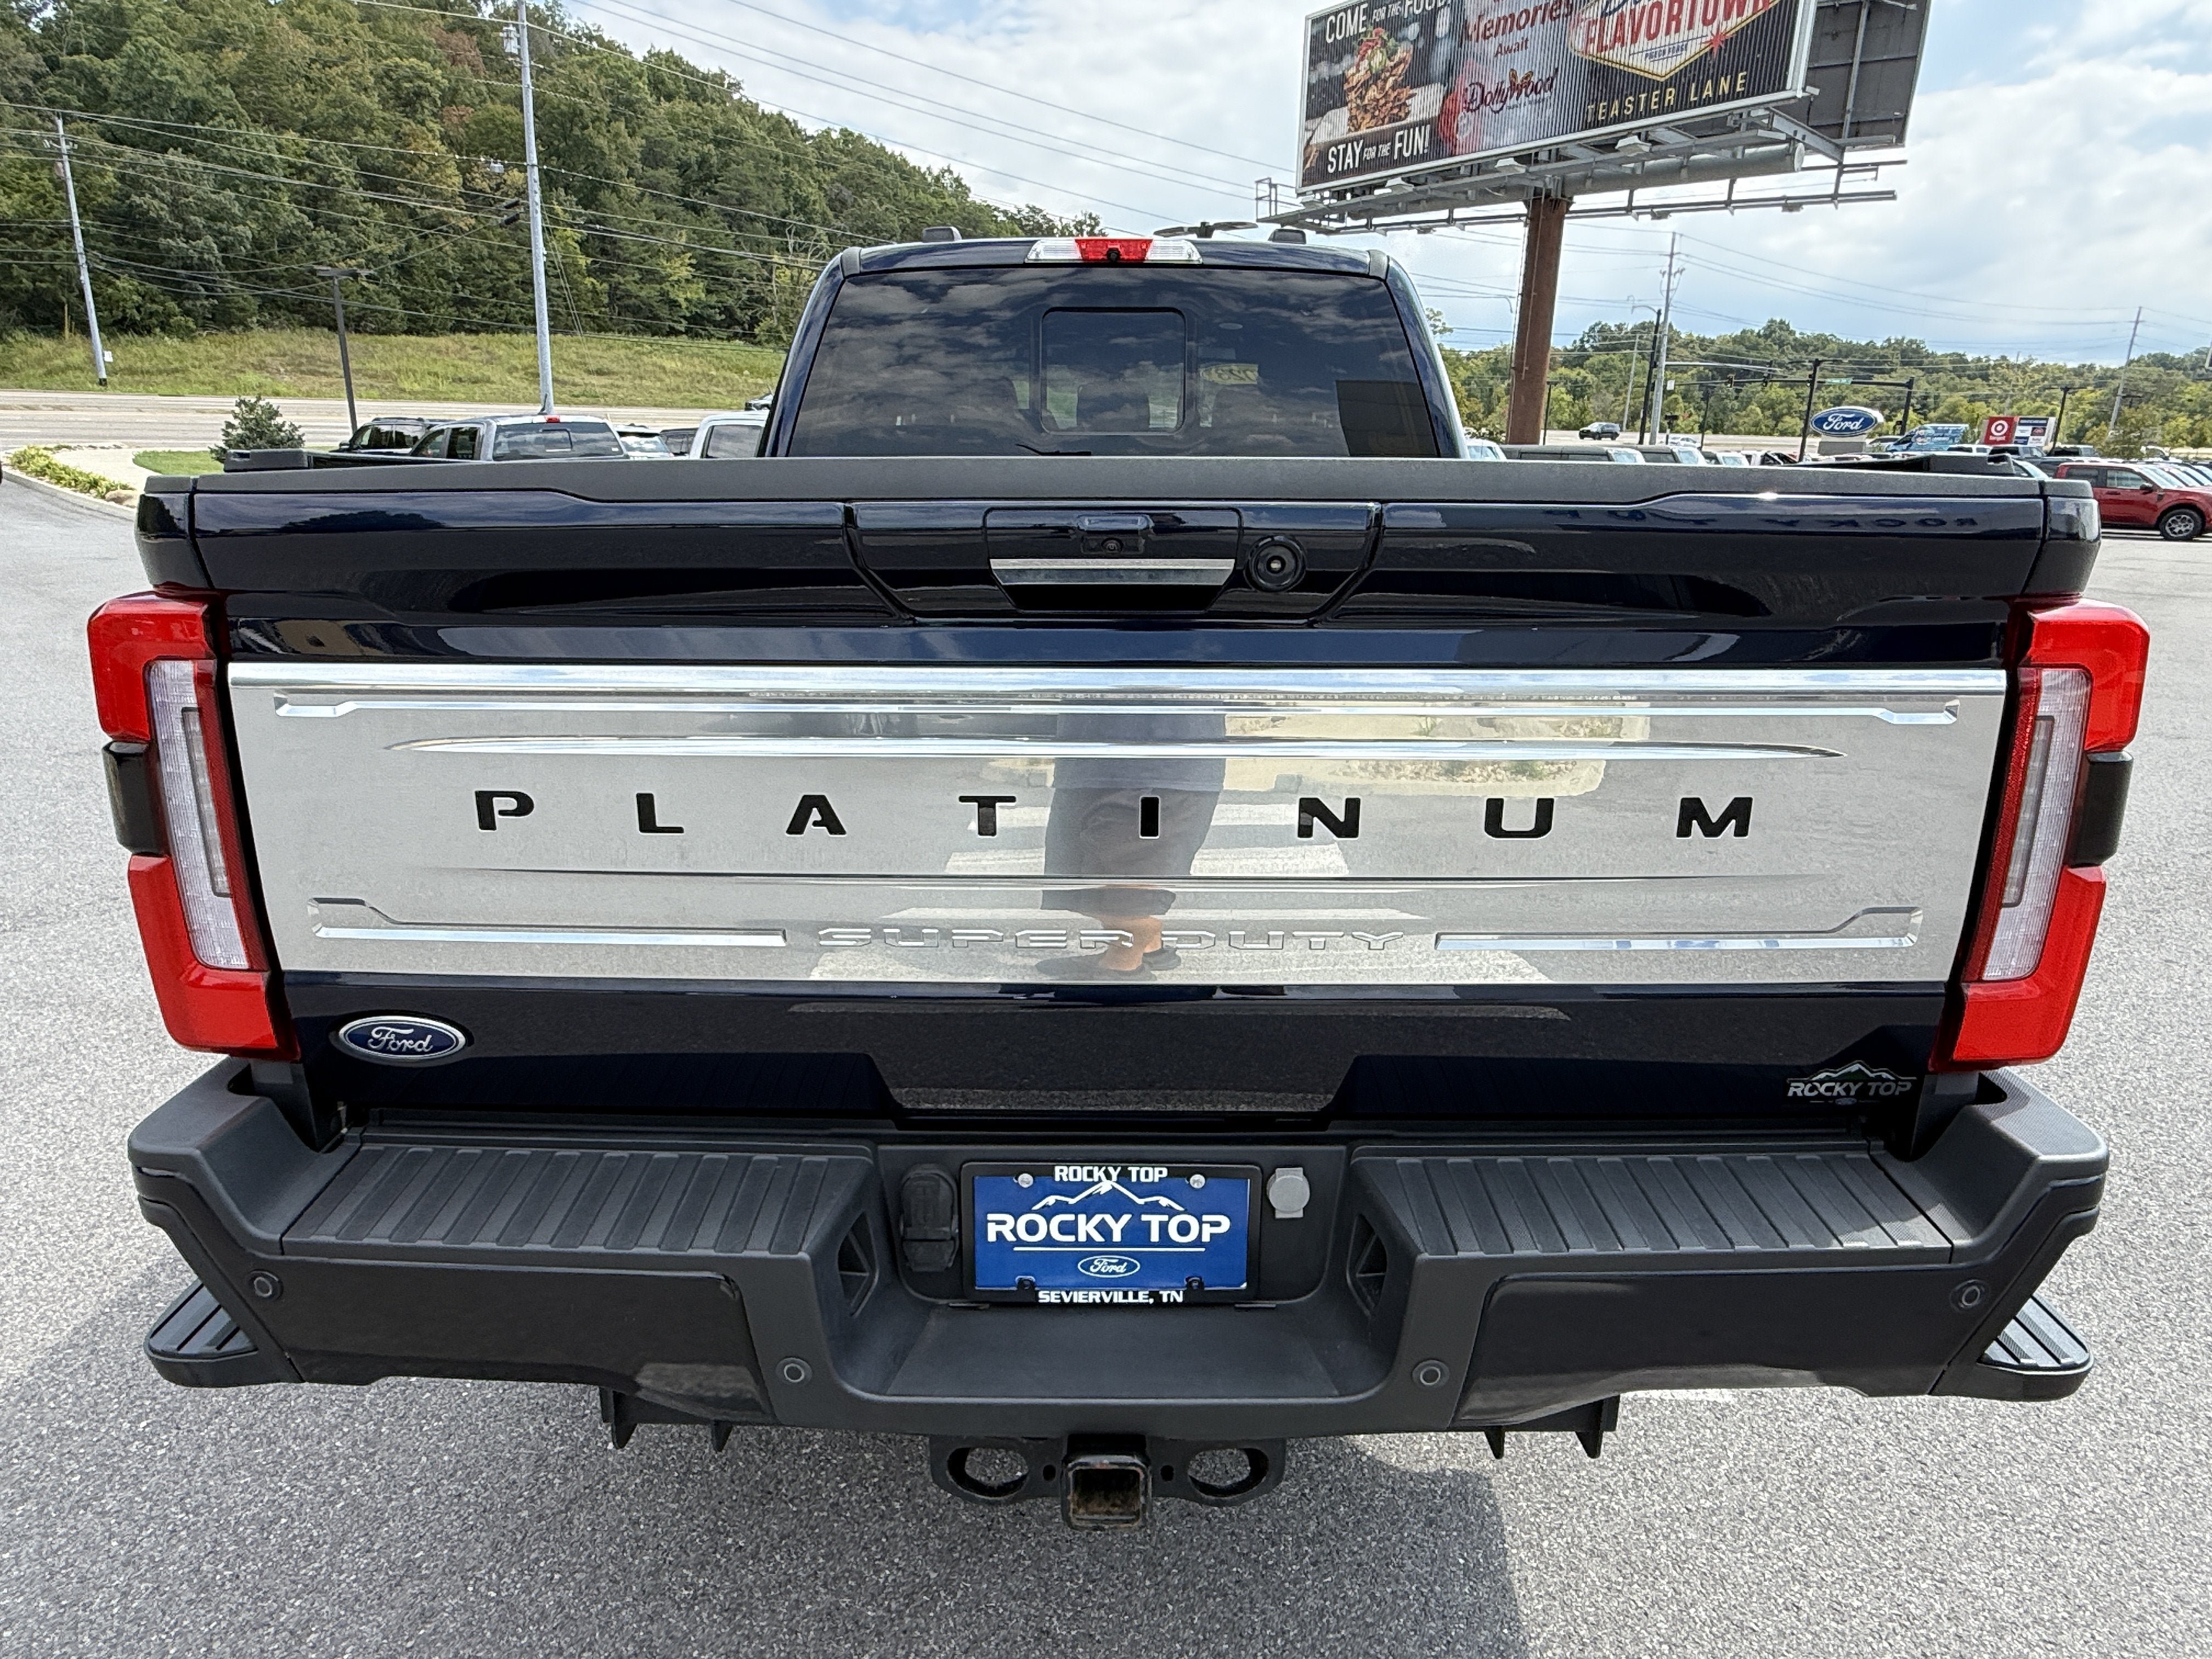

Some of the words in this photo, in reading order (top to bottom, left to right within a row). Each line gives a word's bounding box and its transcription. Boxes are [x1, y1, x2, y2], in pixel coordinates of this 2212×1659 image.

[1326, 3, 1368, 43] COME
[1372, 7, 1387, 23] FOR
[1494, 37, 1529, 57] Await
[1587, 88, 1675, 123] TEASTER
[1690, 71, 1747, 101] LANE
[1328, 139, 1364, 173] STAY
[1363, 145, 1377, 161] FOR
[1378, 142, 1391, 157] THE
[1394, 125, 1430, 160] FUN!
[1822, 413, 1864, 430] Ford
[475, 790, 1753, 839] PLATINUM
[819, 928, 1133, 949] SUPER
[1161, 931, 1403, 950] DUTY
[368, 1026, 433, 1052] Ford
[1787, 1082, 1863, 1096] ROCKY
[1867, 1081, 1912, 1096] TOP
[1054, 1165, 1121, 1183] ROCKY
[1128, 1166, 1167, 1183] TOP
[987, 1214, 1137, 1243] ROCKY
[1141, 1214, 1231, 1243] TOP
[1089, 1258, 1128, 1274] Ford
[1038, 1290, 1154, 1304] SEVIERVILLE,
[1159, 1291, 1183, 1304] TN
